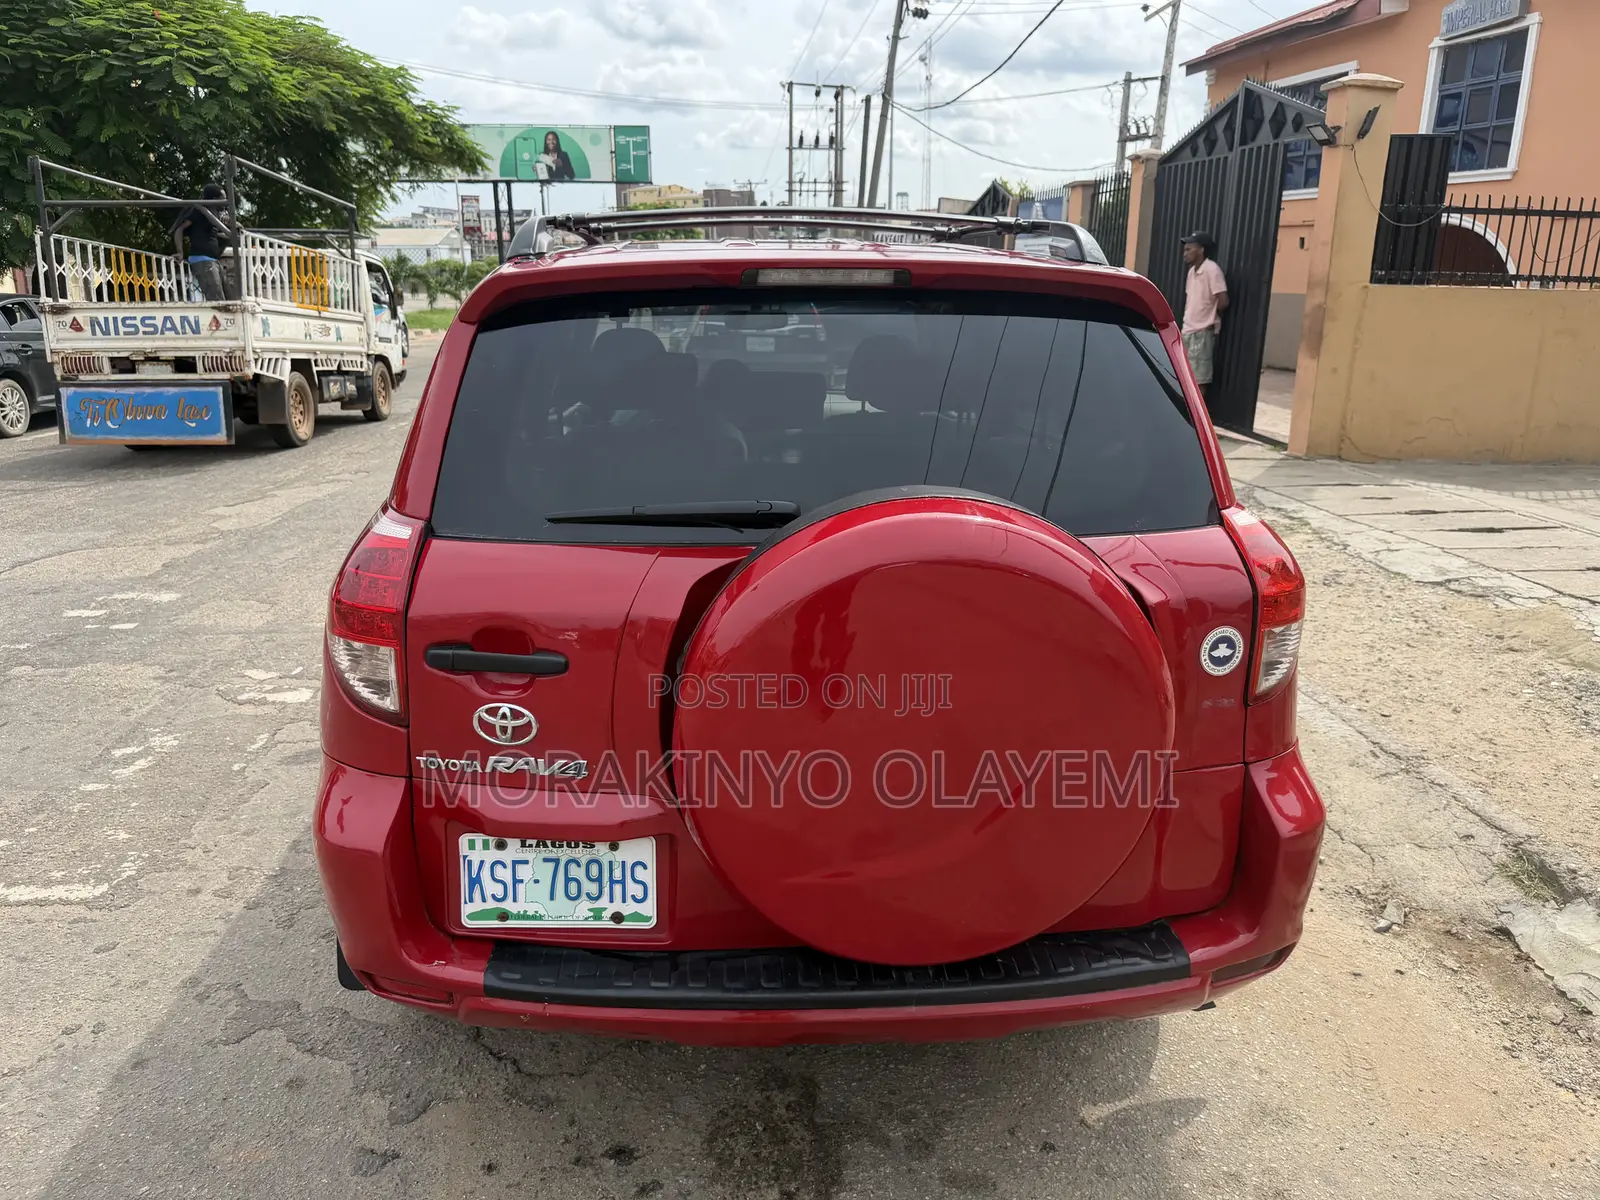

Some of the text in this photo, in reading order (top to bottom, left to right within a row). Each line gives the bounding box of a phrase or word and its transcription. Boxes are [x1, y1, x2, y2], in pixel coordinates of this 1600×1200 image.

[56, 320, 67, 329] 70
[89, 315, 202, 336] NISSAN
[224, 318, 235, 326] 70
[415, 755, 589, 779] TOYOTA RAV4
[519, 839, 596, 849] LAGOS
[466, 857, 649, 904] KSF-769HS
